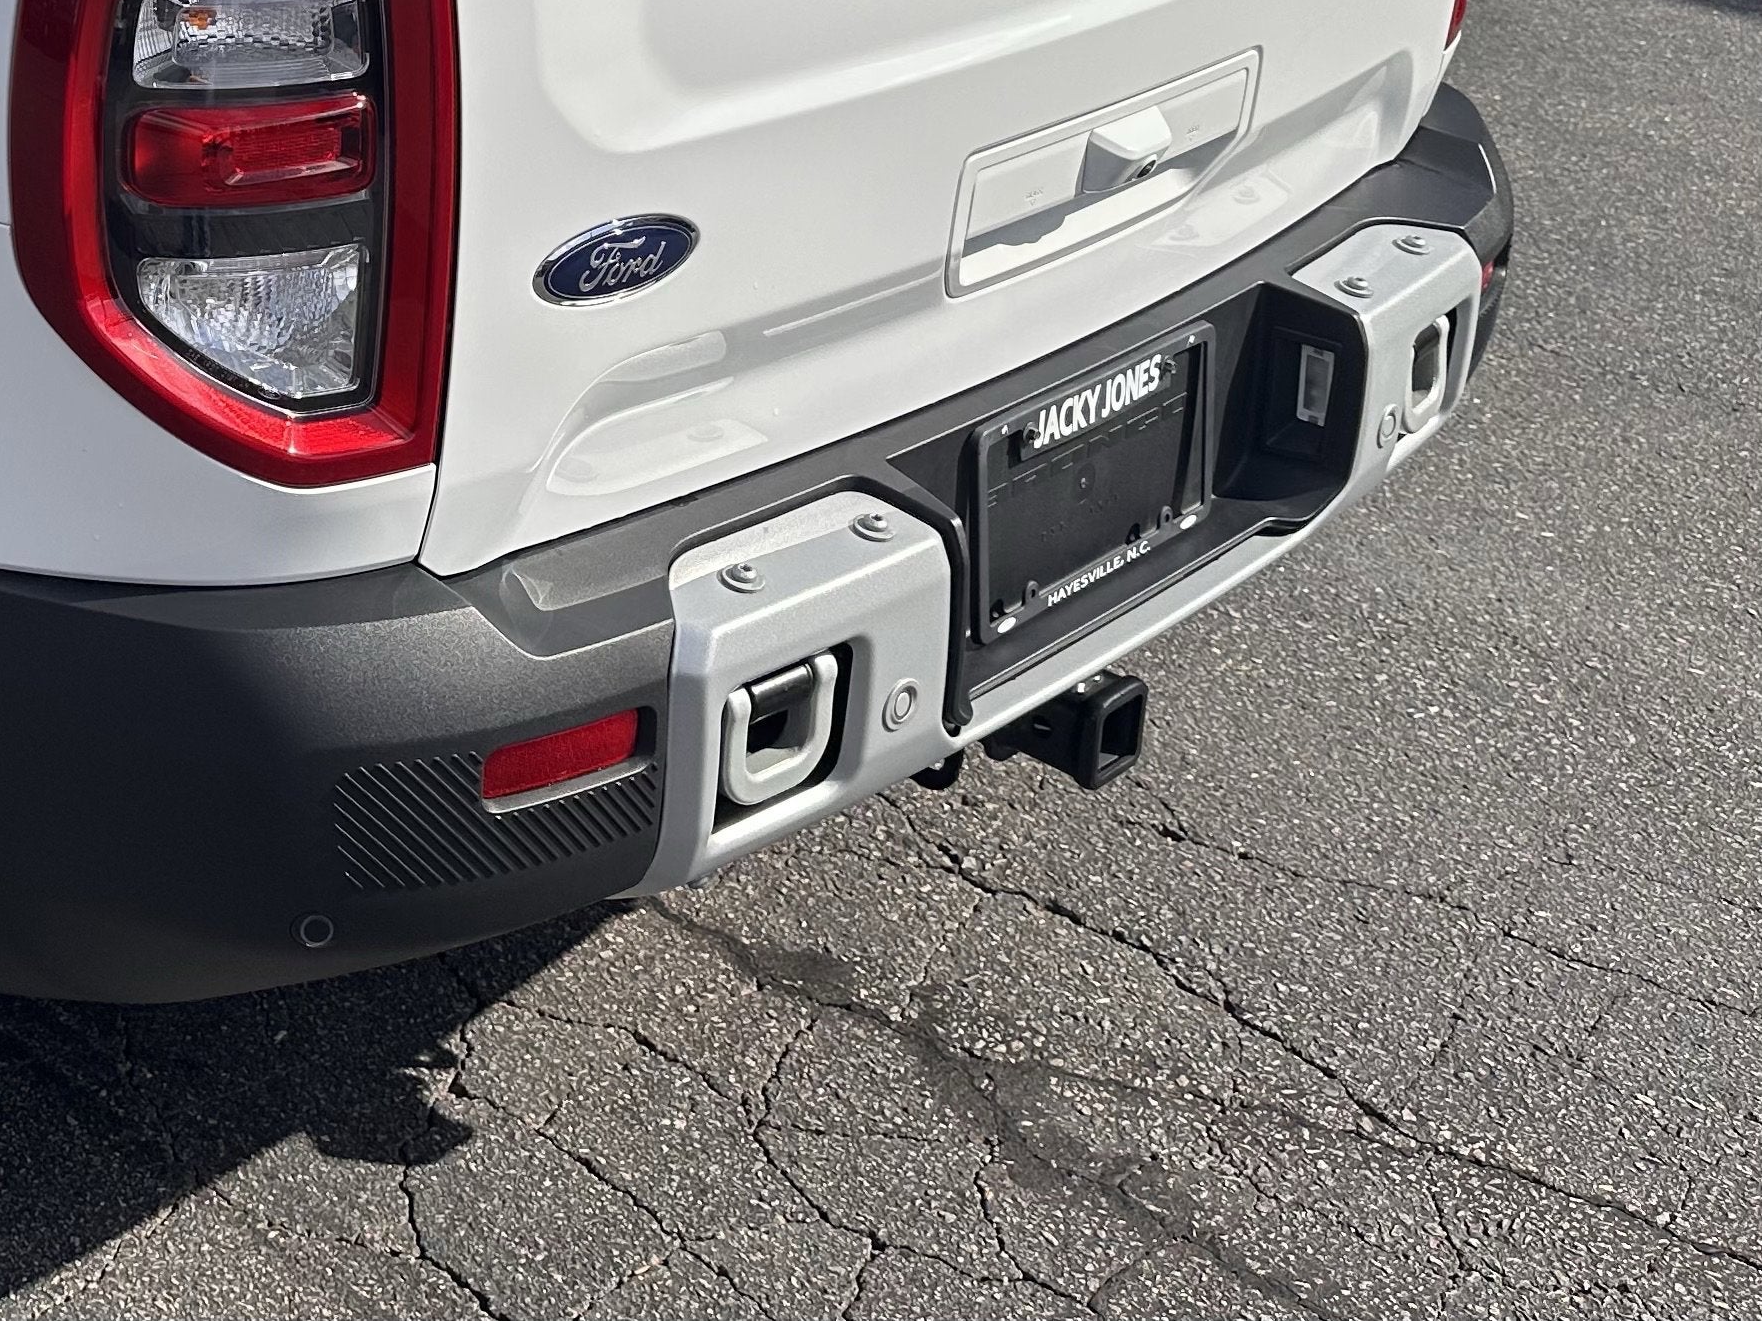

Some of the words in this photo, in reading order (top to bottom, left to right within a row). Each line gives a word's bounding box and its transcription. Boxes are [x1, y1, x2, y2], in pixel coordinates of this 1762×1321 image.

[578, 235, 667, 293] Ford
[1033, 382, 1102, 449] JACKY
[1101, 353, 1162, 420] JONES
[1126, 540, 1151, 562] N.C.
